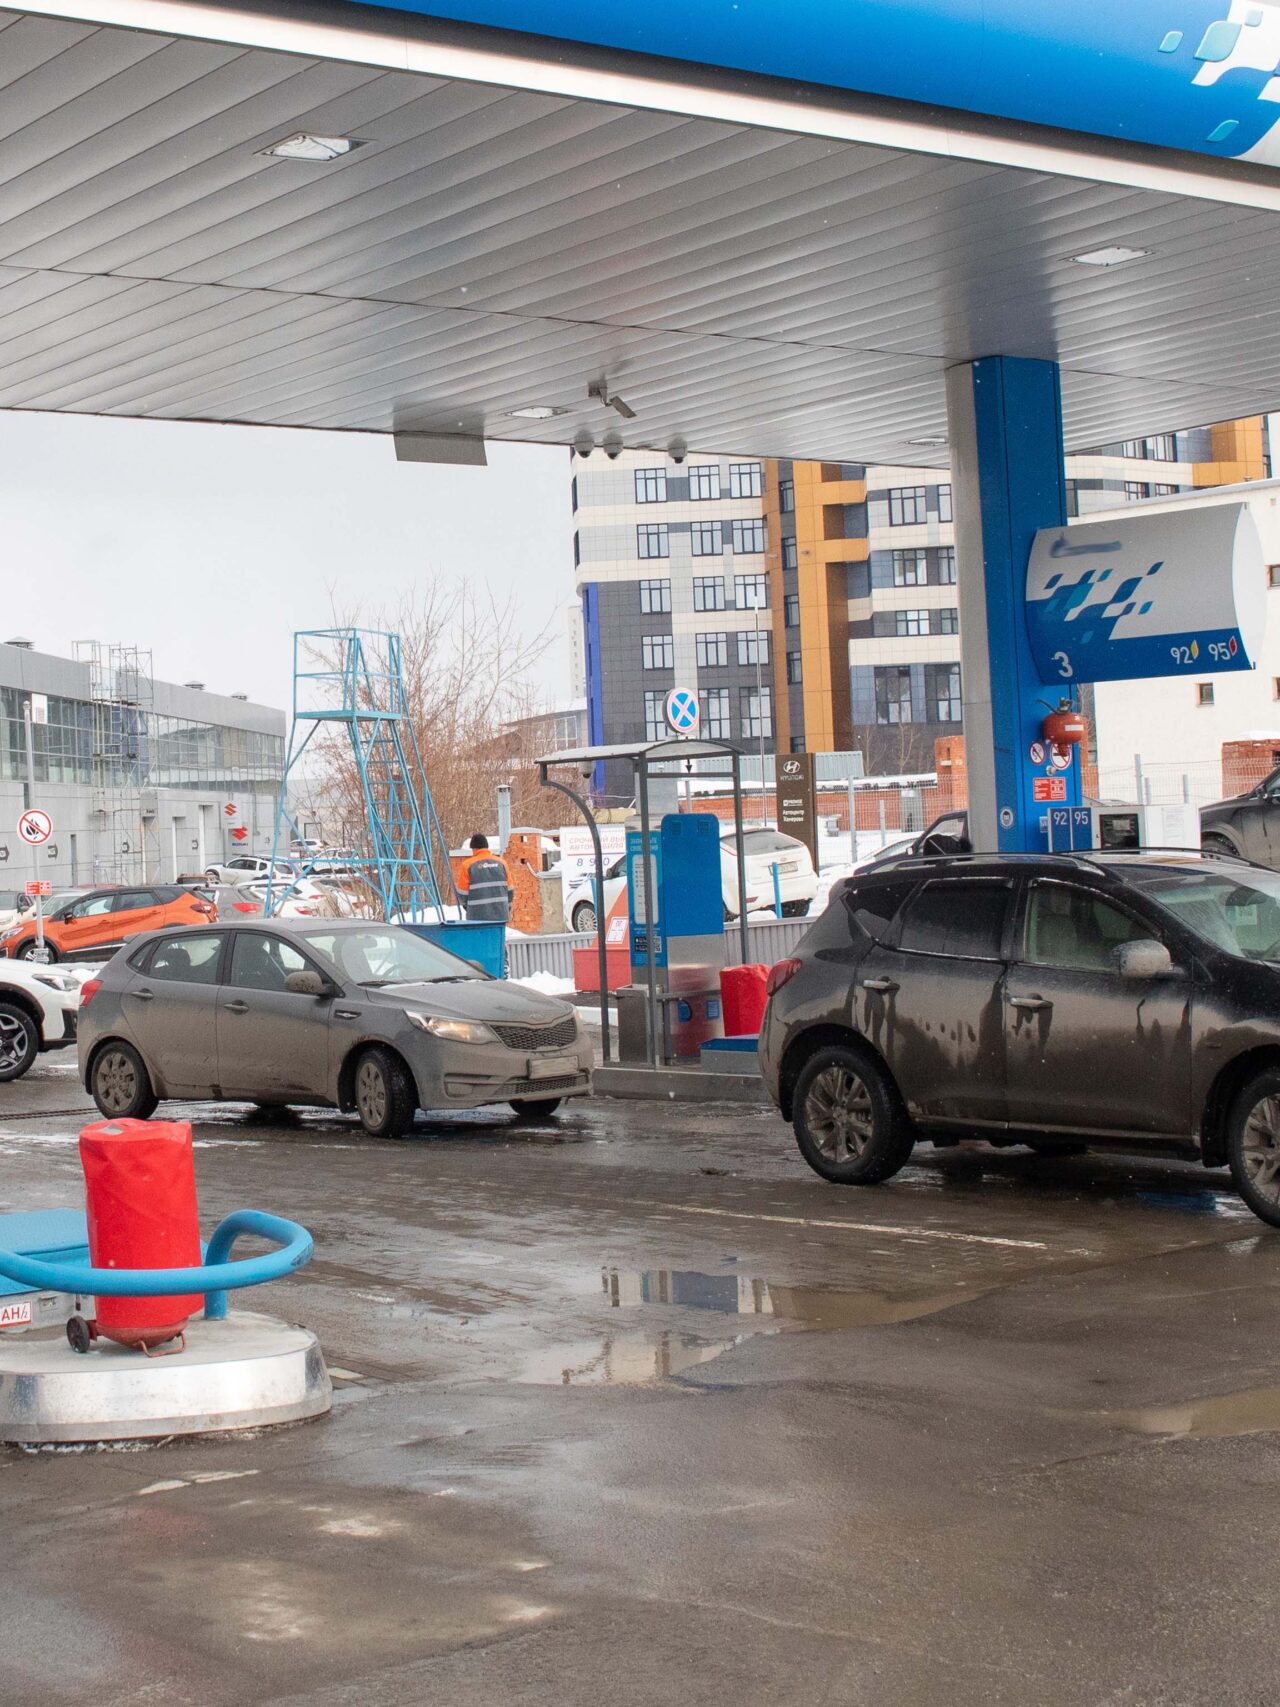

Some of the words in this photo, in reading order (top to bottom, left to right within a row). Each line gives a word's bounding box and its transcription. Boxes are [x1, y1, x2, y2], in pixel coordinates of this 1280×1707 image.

[1170, 646, 1193, 665] 92
[1208, 642, 1231, 662] 95
[1054, 651, 1073, 678] 3
[1053, 811, 1068, 826] 92
[1074, 811, 1089, 825] 95
